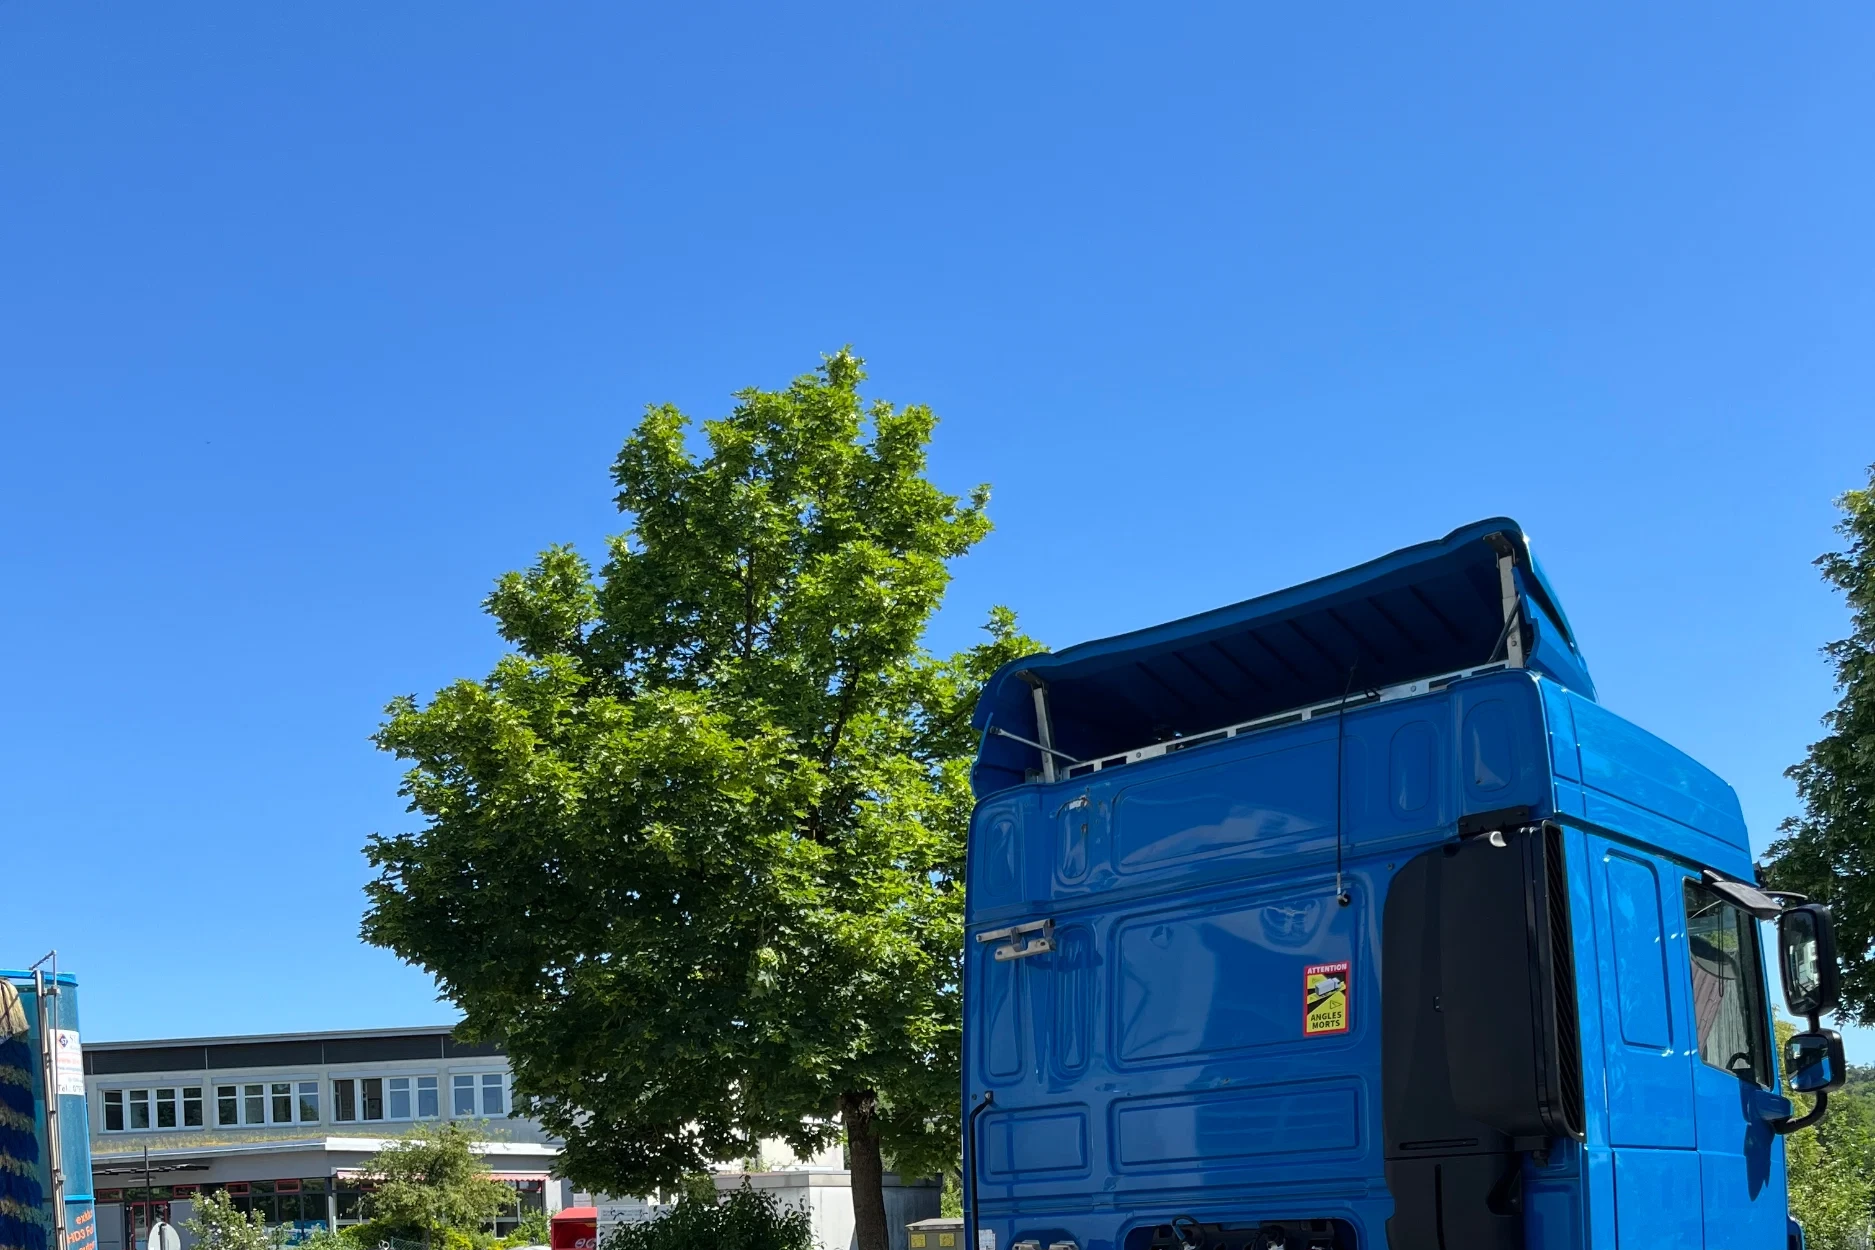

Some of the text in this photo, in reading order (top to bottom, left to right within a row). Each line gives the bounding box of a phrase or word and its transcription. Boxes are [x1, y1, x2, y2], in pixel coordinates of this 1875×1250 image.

[1307, 963, 1347, 974] ATTENTION
[1311, 1011, 1342, 1021] ANGLES
[1312, 1020, 1340, 1029] MORTS
